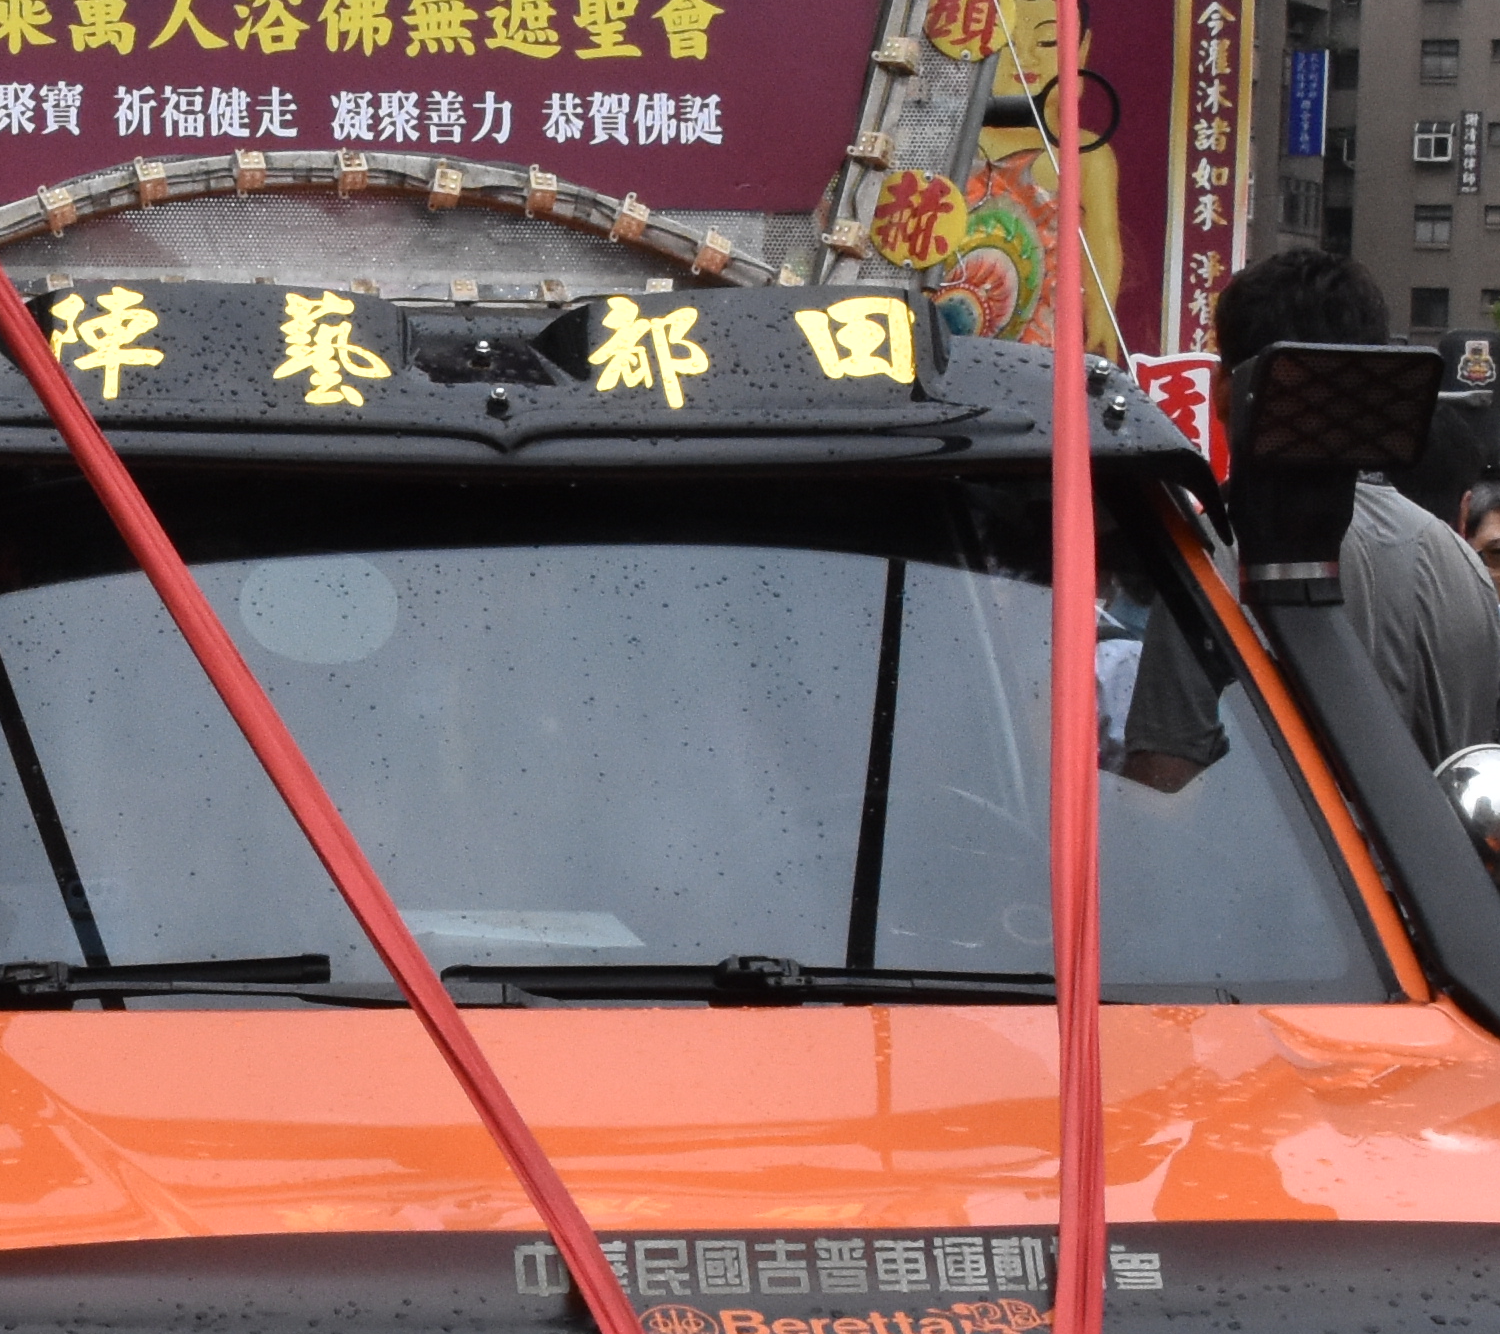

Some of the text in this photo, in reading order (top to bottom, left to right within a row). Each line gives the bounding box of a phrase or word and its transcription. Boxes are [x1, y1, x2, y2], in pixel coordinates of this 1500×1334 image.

[113, 84, 299, 139] 祈福健走
[330, 90, 514, 143] 凝聚善力
[542, 92, 724, 146] 恭賀佛誕
